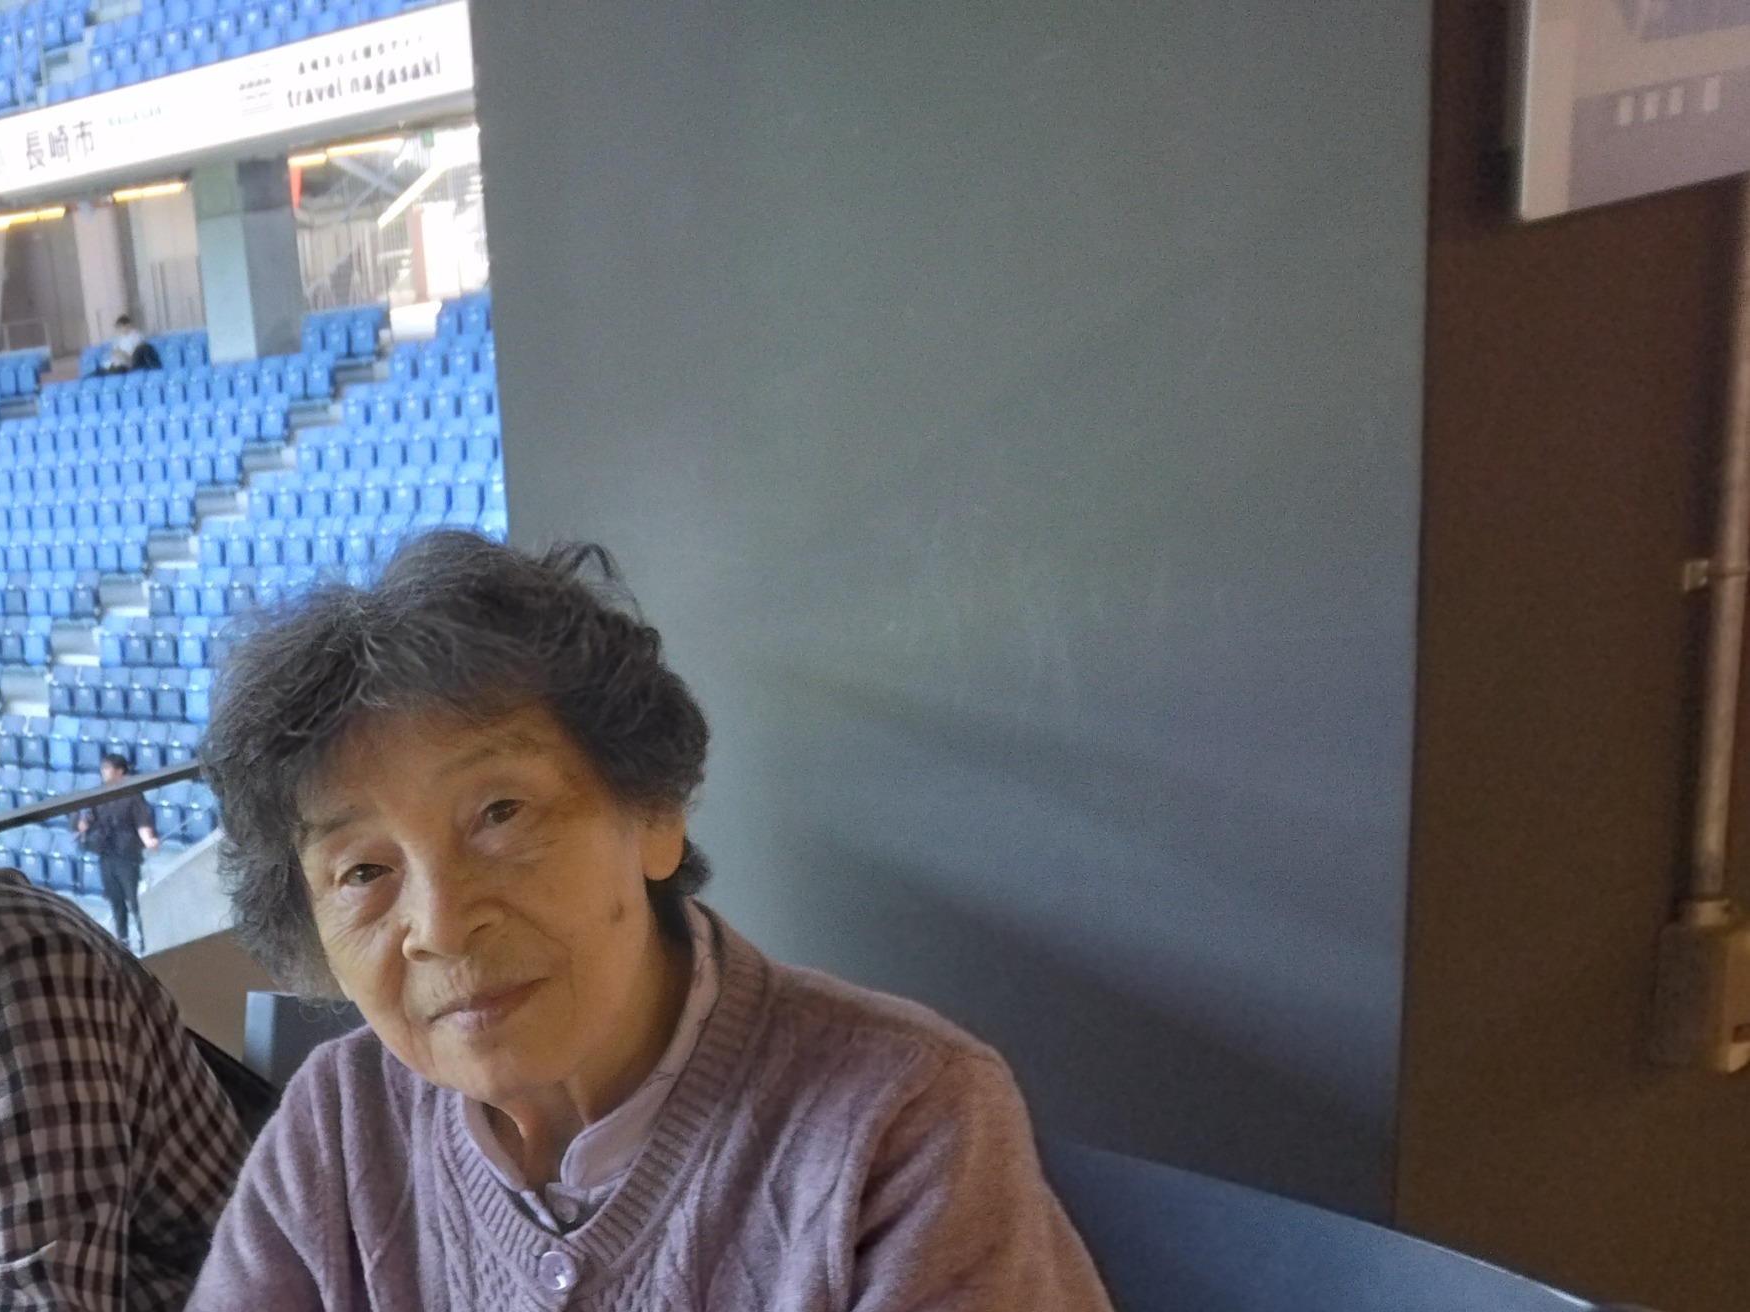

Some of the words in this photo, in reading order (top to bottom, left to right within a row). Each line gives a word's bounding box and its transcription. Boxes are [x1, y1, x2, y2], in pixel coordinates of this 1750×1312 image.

[286, 76, 343, 109] travel
[349, 51, 442, 95] nagasaki
[24, 120, 96, 171] 長崎市
